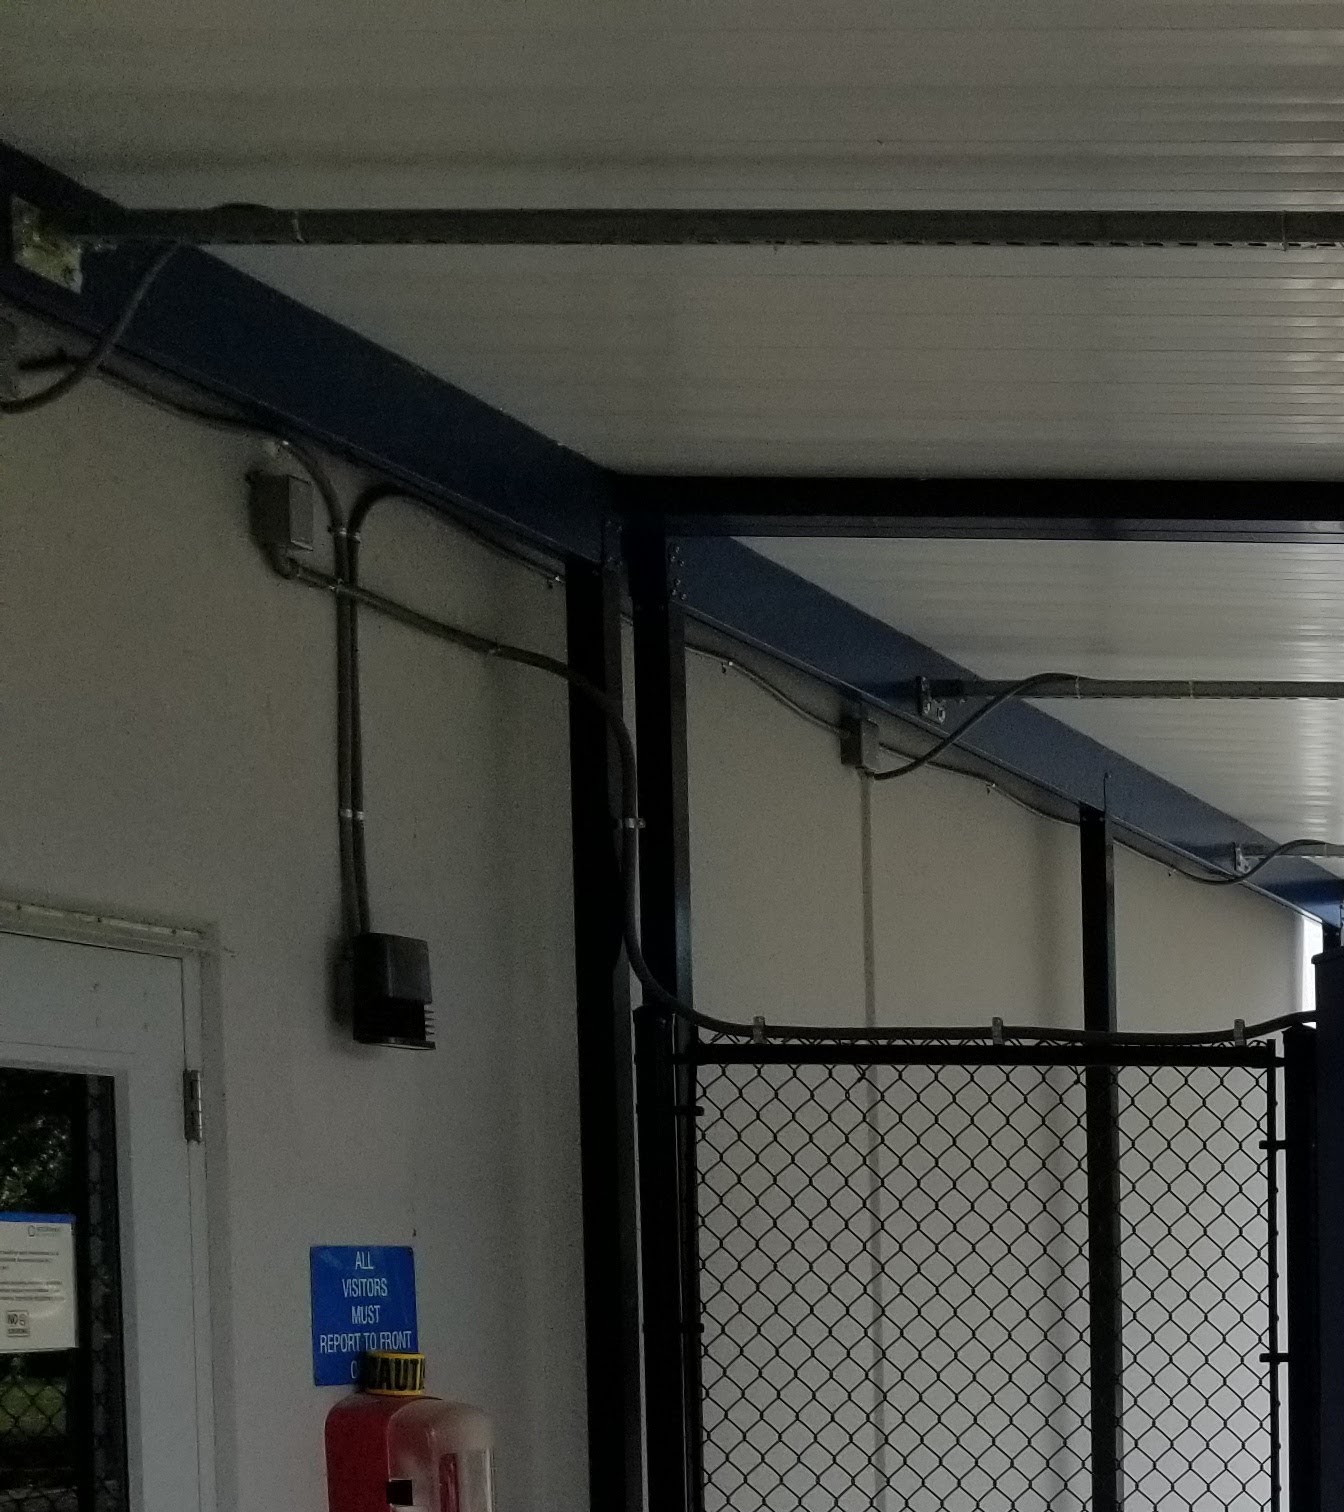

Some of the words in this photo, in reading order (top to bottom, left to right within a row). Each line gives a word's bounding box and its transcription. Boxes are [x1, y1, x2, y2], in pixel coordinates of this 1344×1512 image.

[355, 1251, 374, 1270] ALL
[341, 1278, 388, 1298] VISITORS
[351, 1305, 381, 1325] MUST
[319, 1333, 361, 1355] REPORT
[363, 1332, 377, 1351] TO
[379, 1330, 412, 1351] FRONT
